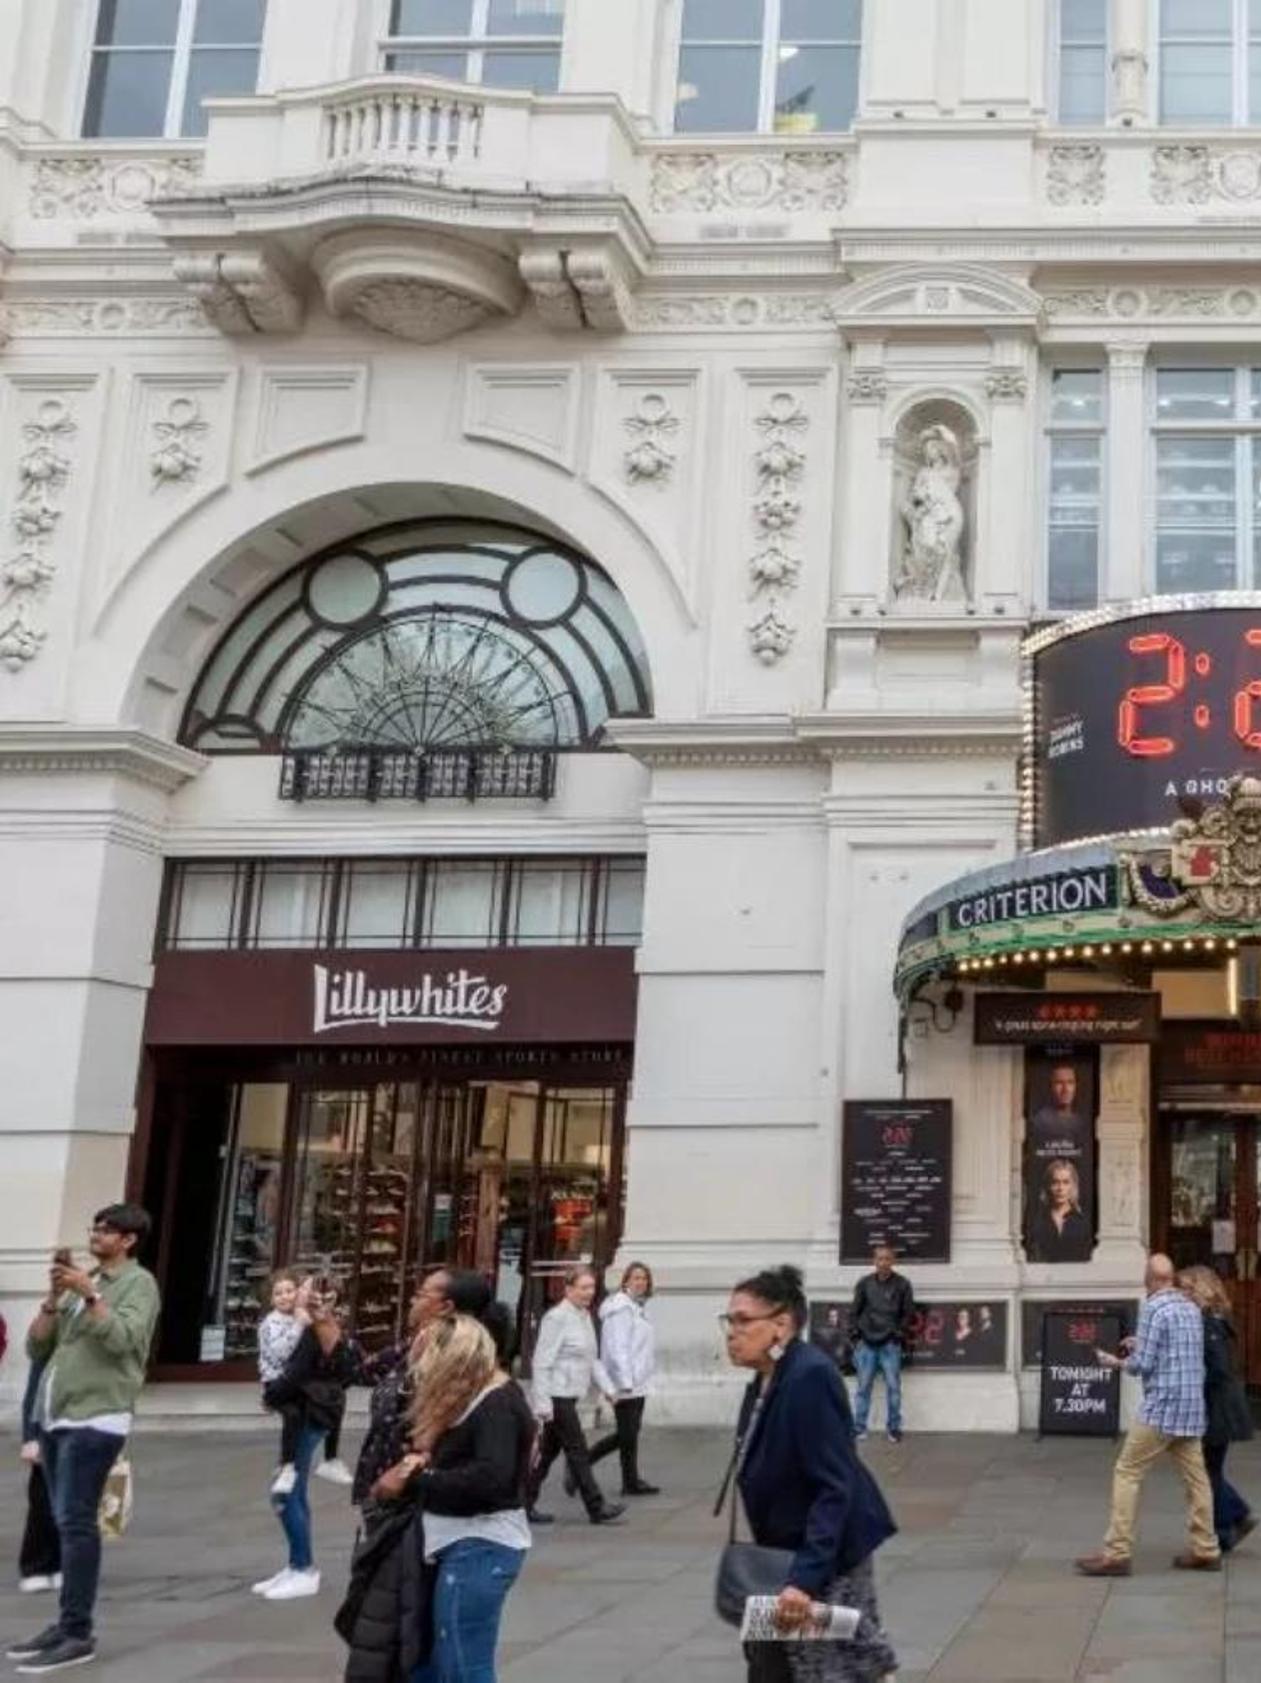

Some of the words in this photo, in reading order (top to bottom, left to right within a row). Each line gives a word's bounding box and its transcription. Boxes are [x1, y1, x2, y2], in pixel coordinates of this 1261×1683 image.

[1164, 780, 1178, 796] A
[958, 873, 1107, 927] CRITERION
[313, 964, 508, 1033] Lillywhites
[1050, 1366, 1112, 1381] TONIGHT
[1071, 1383, 1091, 1397] AT
[1055, 1398, 1106, 1413] 7.30PM
